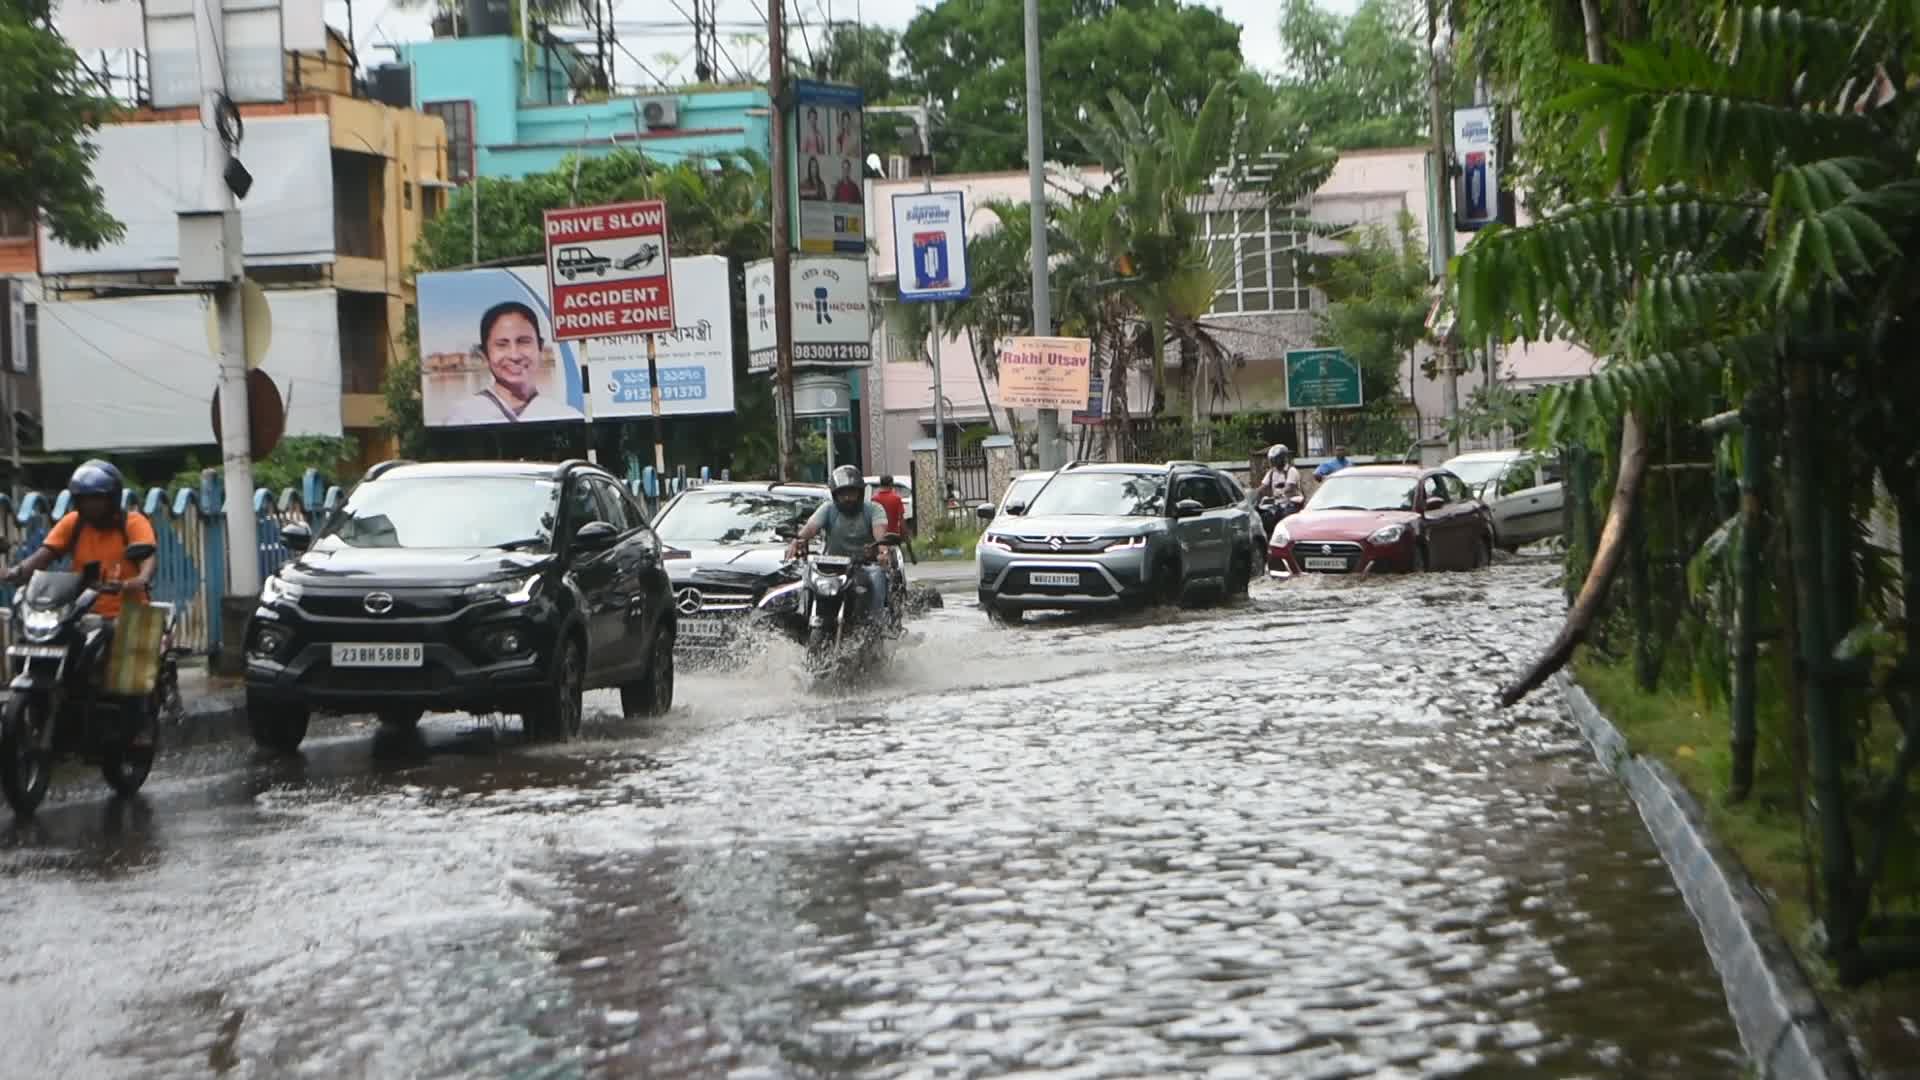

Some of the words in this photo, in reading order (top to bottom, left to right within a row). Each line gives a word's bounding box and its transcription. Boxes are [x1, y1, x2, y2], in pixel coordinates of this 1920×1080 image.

[548, 216, 604, 235] DRIVE
[608, 210, 661, 229] SLOW
[564, 287, 659, 309] ACCIDENT
[556, 311, 616, 329] PRONE
[621, 305, 670, 324] ZONE
[795, 344, 869, 360] 9830012199
[1003, 352, 1042, 364] Rakhi
[1047, 352, 1087, 366] Utsav
